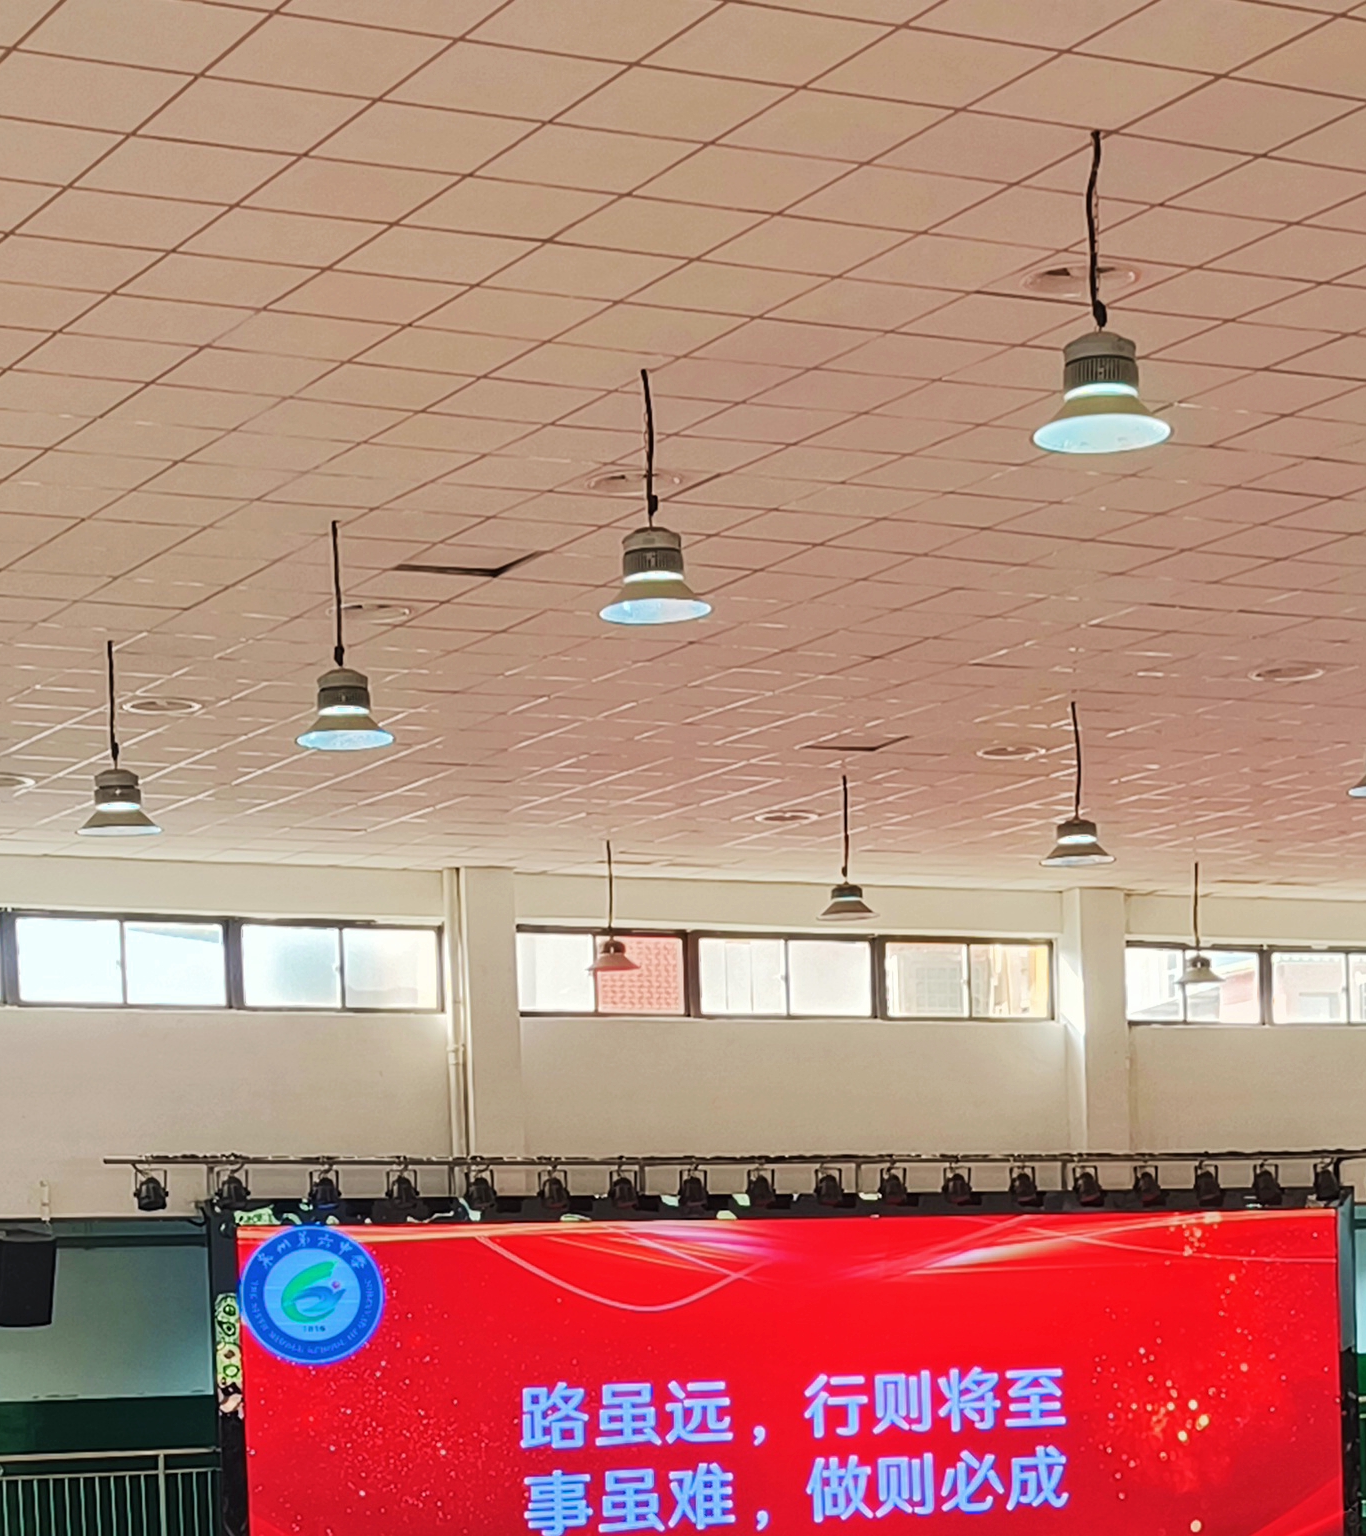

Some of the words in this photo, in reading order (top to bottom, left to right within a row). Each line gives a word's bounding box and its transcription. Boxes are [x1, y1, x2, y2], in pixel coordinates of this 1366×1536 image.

[519, 1366, 1068, 1449] 路虽远，行则将至
